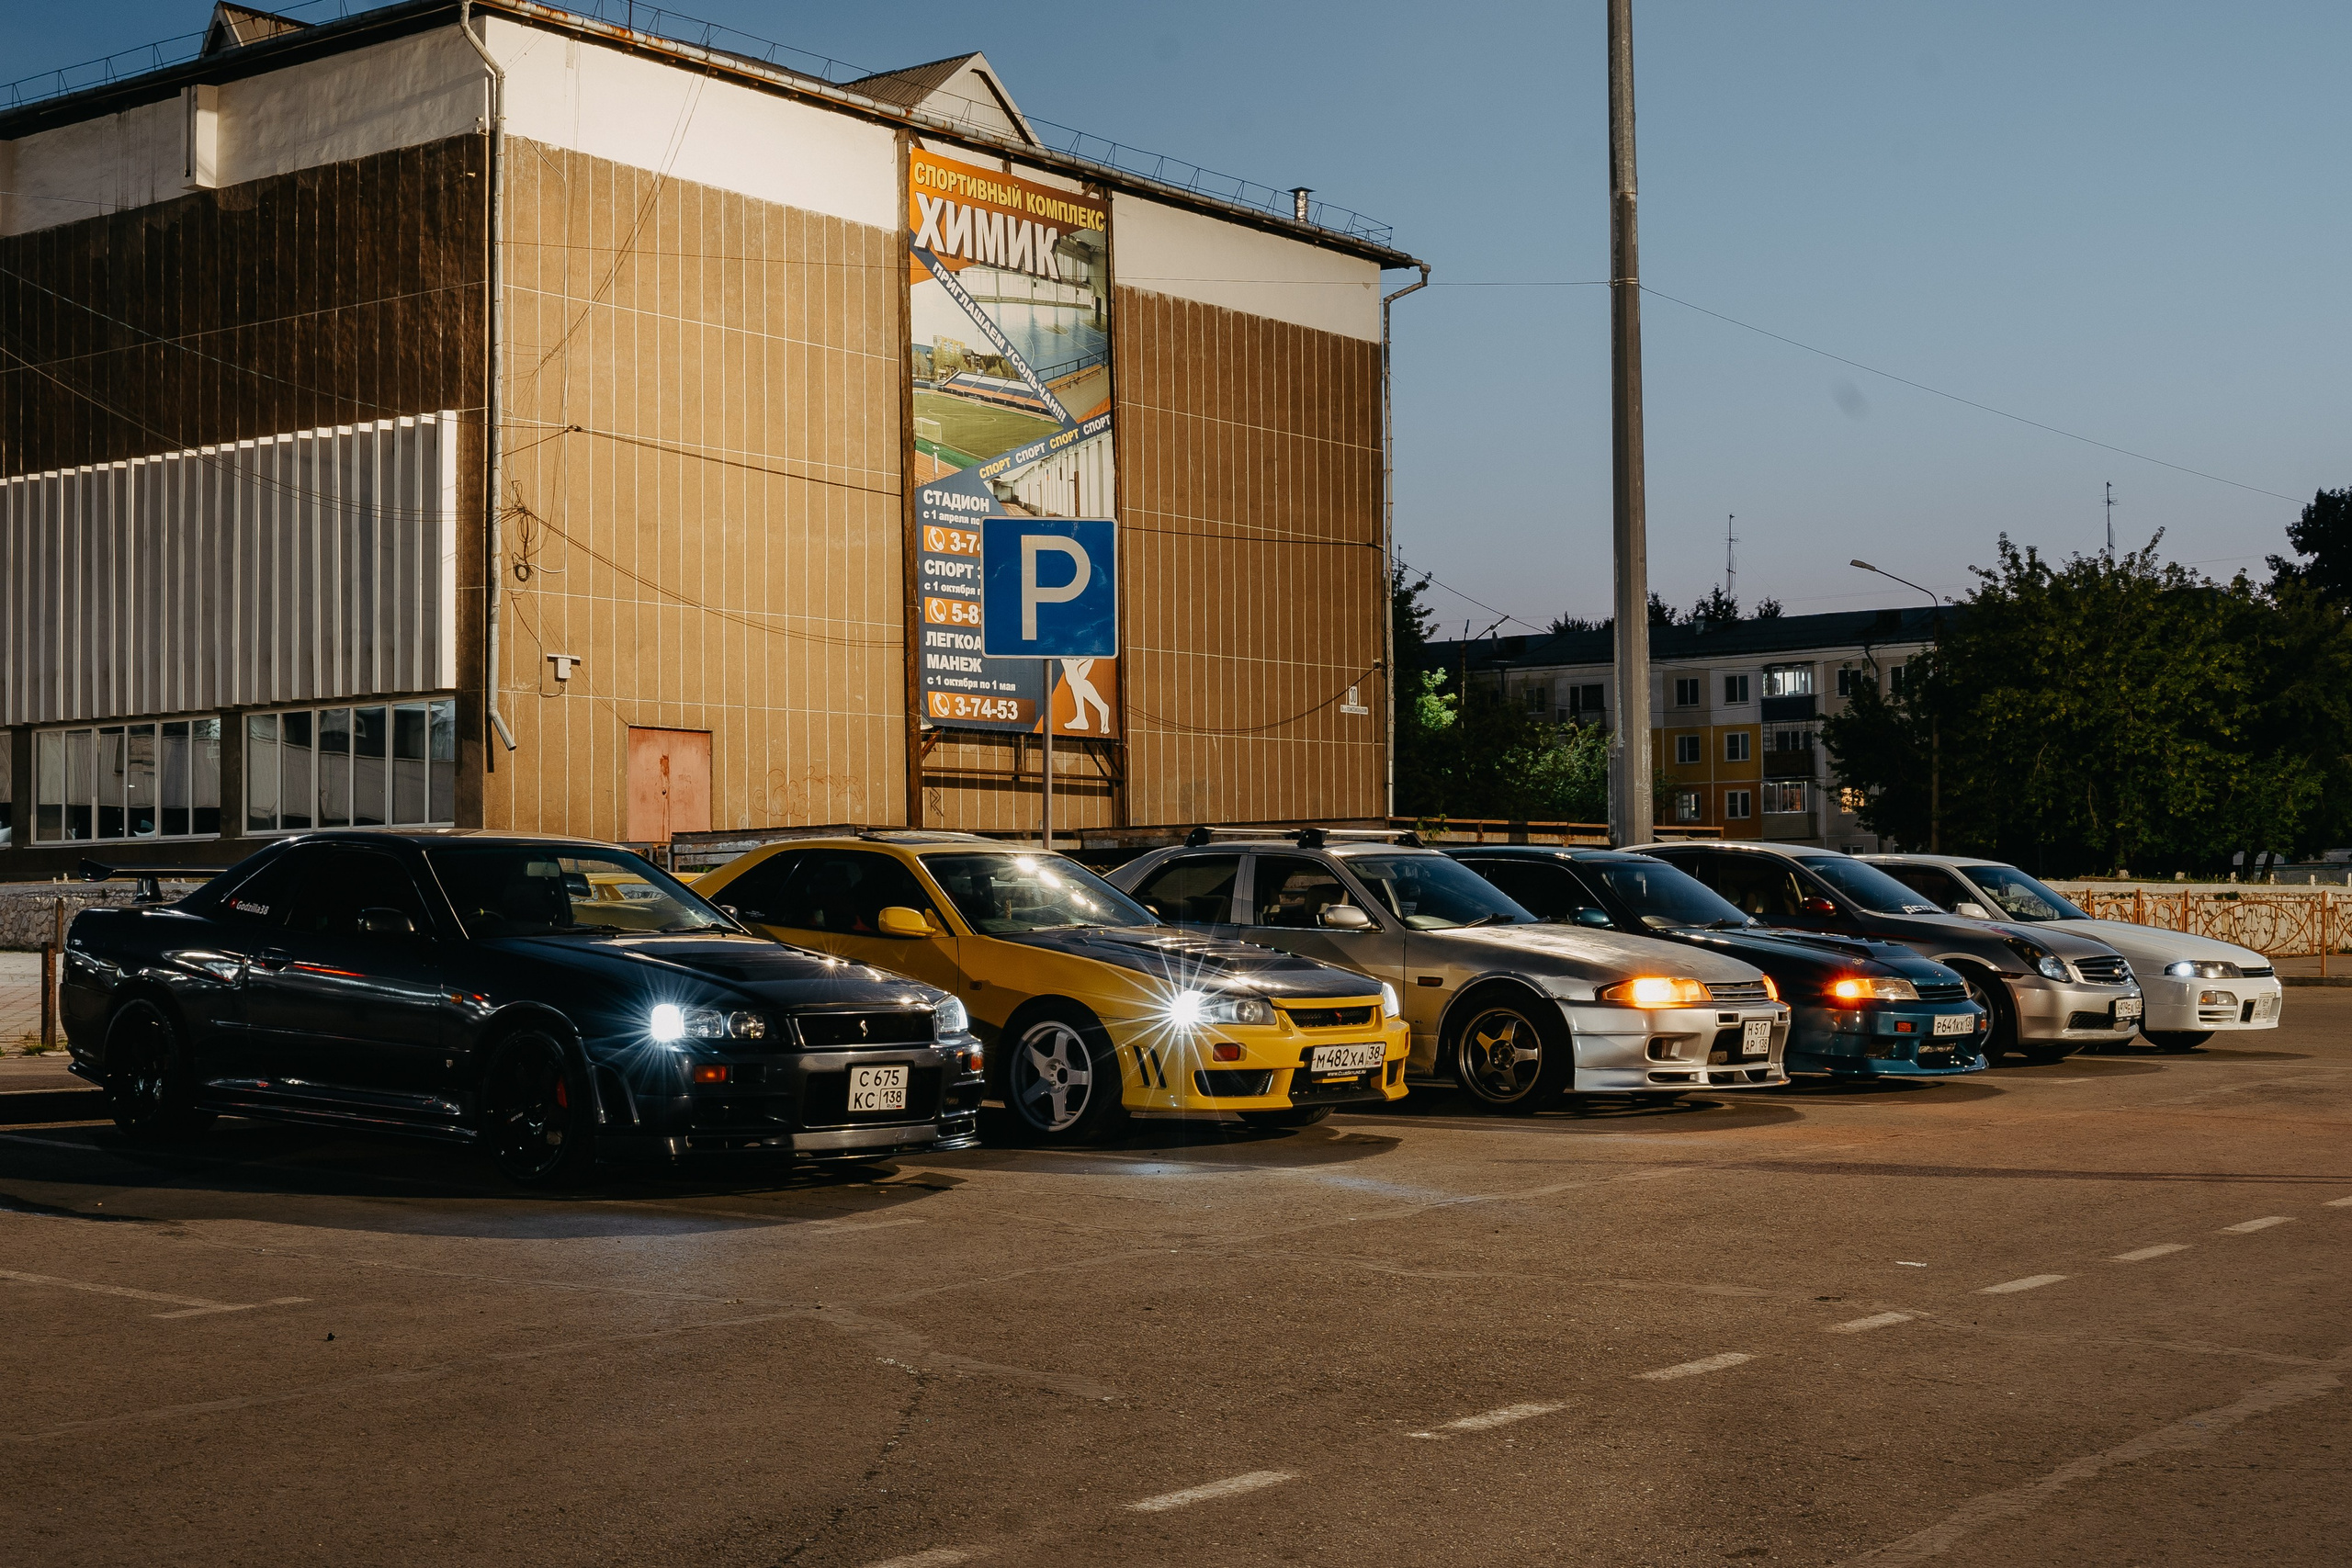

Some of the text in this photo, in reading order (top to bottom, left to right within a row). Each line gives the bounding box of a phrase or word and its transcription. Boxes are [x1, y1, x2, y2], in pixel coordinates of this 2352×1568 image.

[914, 162, 1105, 232] СПОРТИВНЫЙ КОМПЛЕКС
[914, 191, 1063, 279] ХИМИК
[933, 261, 1067, 423] ПРИГЛАШАЕМ УСОЛЬЧАН!!!
[978, 414, 1111, 479] СПОРТ СПОРТ СПОРТ СПОРТ
[923, 489, 990, 513] СТАДИОН
[923, 509, 980, 526] с 1 апреля по
[924, 559, 974, 580] СПОРТ
[924, 582, 931, 591] с
[933, 581, 939, 592] 1
[941, 584, 976, 597] октября
[1022, 535, 1091, 641] P
[952, 603, 981, 625] 5-8
[926, 653, 982, 673] МАНЕЖ
[927, 675, 1016, 692] с 1 октября по 1 мая
[955, 696, 1019, 720] 3-74-53
[236, 900, 269, 915] Godzilla38
[1748, 1023, 1768, 1036] Н 517
[1316, 1045, 1381, 1068] М482ХА 38
[1745, 1039, 1756, 1053] АР
[859, 1069, 900, 1088] С 675
[854, 1090, 902, 1109] КС 138
